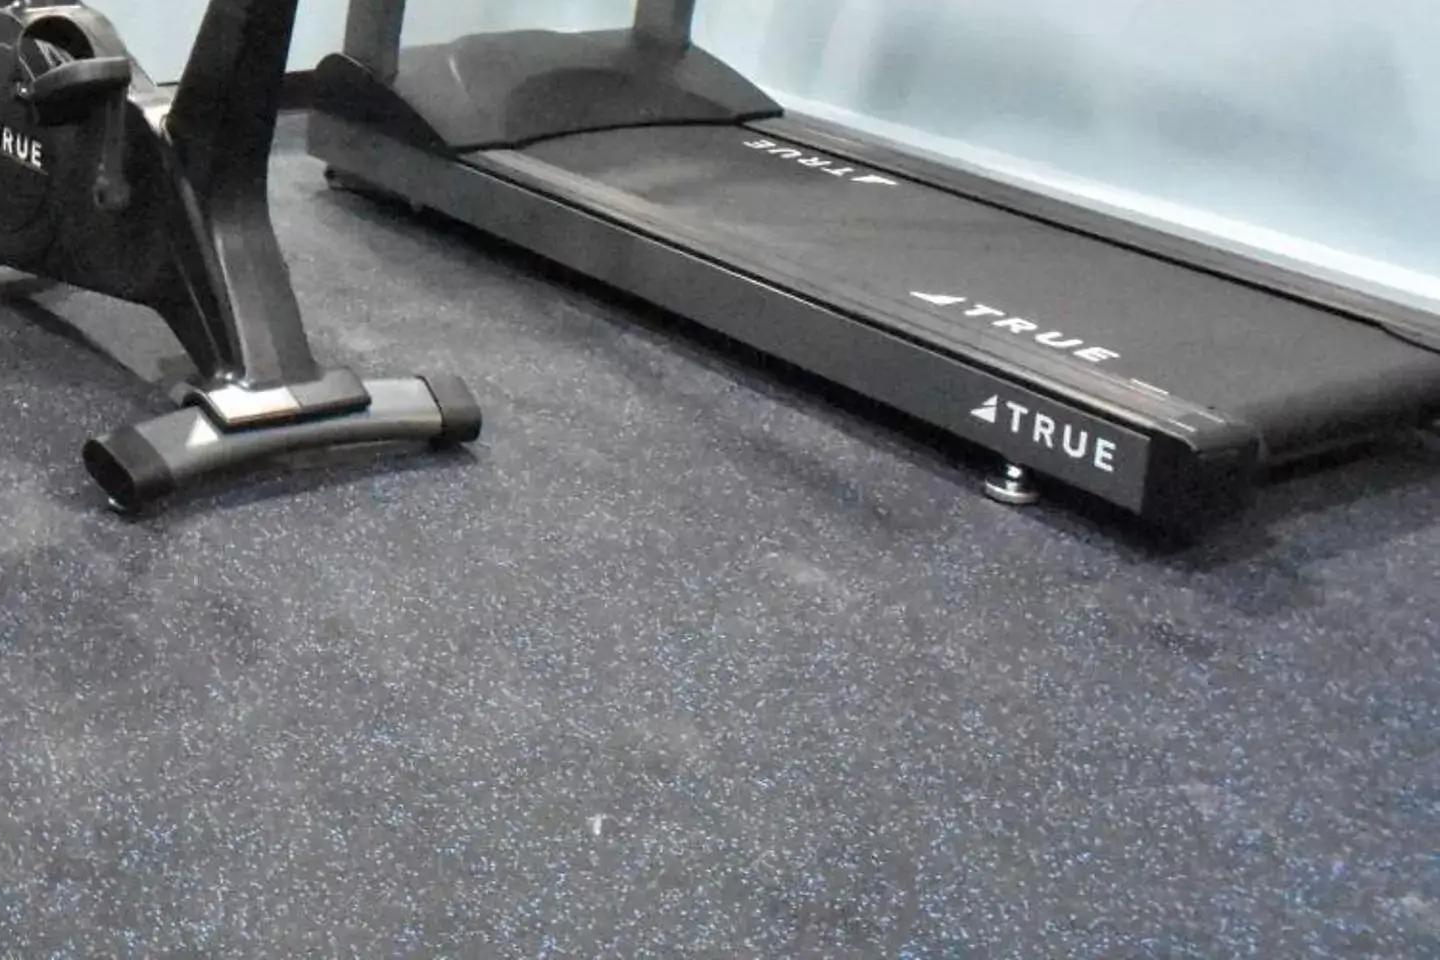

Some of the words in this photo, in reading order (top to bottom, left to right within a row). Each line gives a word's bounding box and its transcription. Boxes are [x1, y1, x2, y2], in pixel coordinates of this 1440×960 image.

[742, 139, 854, 177] TRUE
[964, 303, 1121, 362] TRUE
[1005, 400, 1117, 472] TRUE
